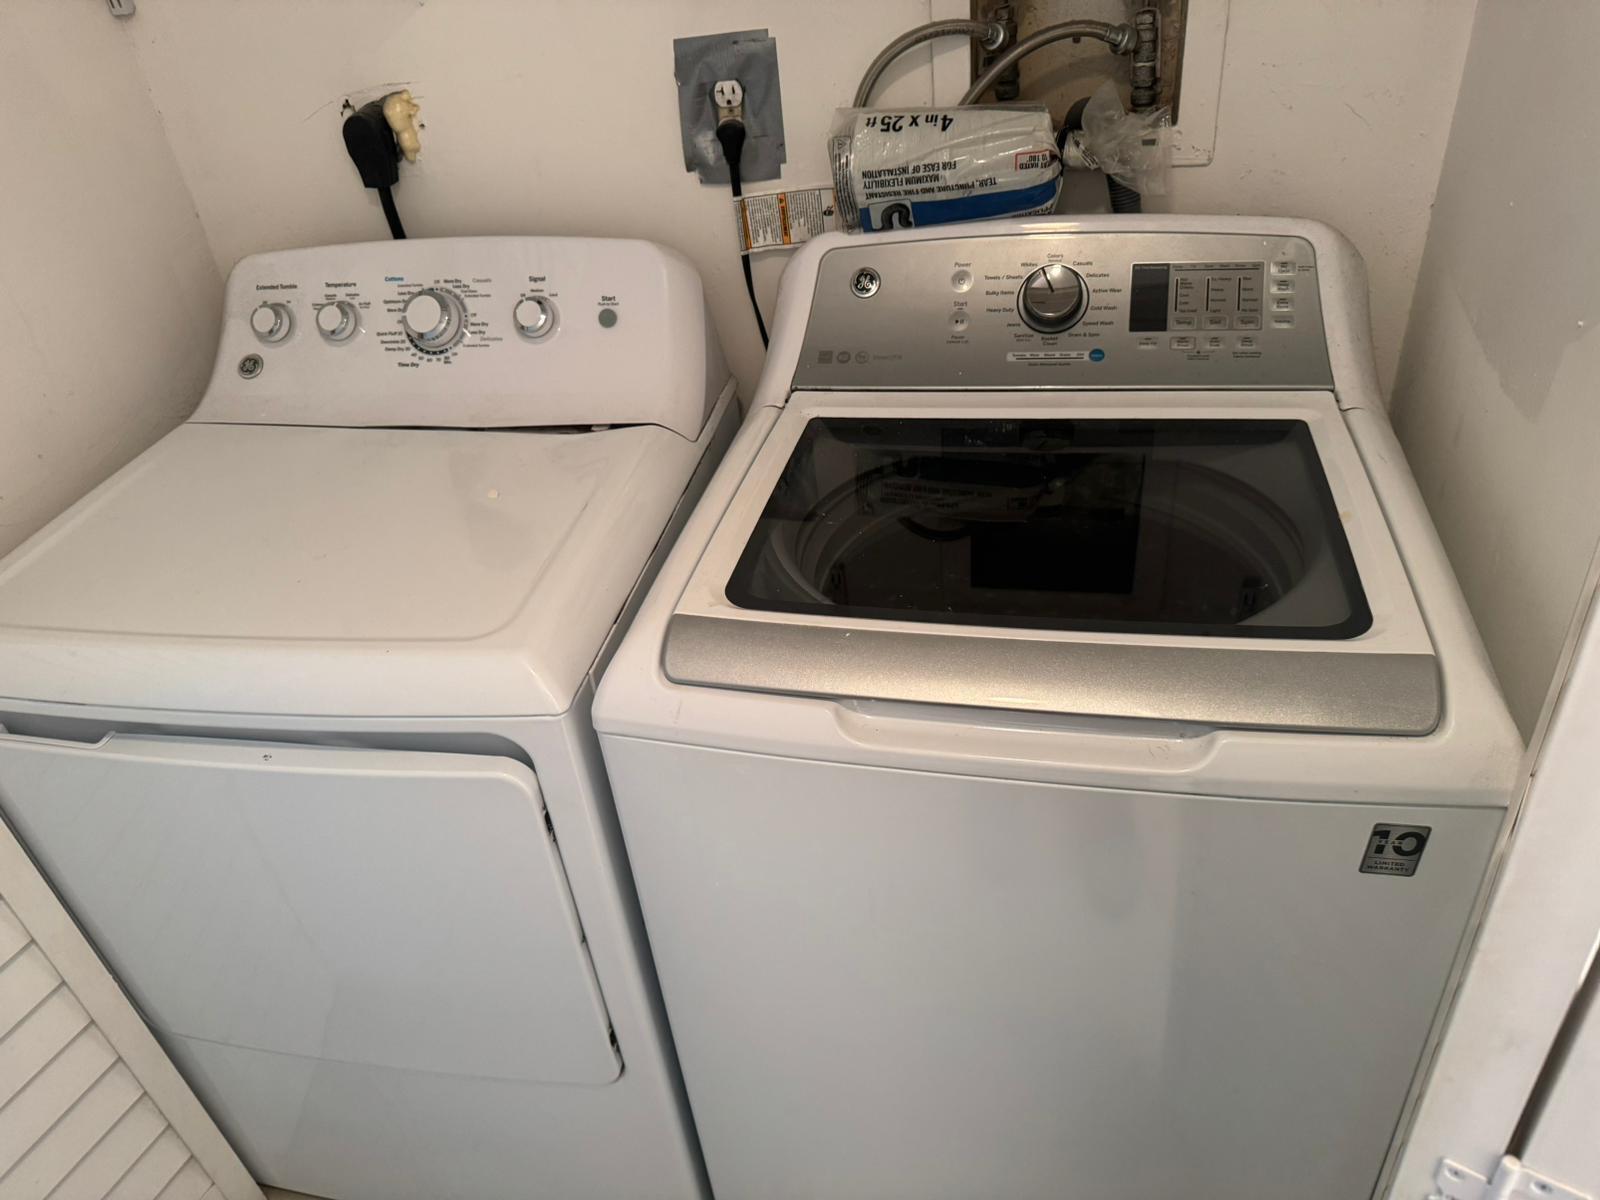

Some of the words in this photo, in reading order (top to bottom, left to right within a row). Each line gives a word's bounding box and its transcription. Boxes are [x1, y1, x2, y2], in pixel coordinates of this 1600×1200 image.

[865, 116, 877, 128] ft
[880, 115, 905, 132] 25
[925, 114, 939, 127] in
[941, 114, 954, 132] 4
[862, 164, 910, 179] INSTALLATION
[912, 164, 921, 174] OF
[922, 162, 940, 173] EASE
[941, 161, 957, 170] FOR
[863, 177, 904, 189] FLEXIBILITY
[905, 174, 940, 185] MAXIMUM
[975, 177, 998, 188] TEAR,
[936, 181, 975, 193] PUNCTURE
[865, 190, 901, 200] RESISTANT
[528, 275, 546, 283] Signal
[1372, 829, 1426, 857] 10
